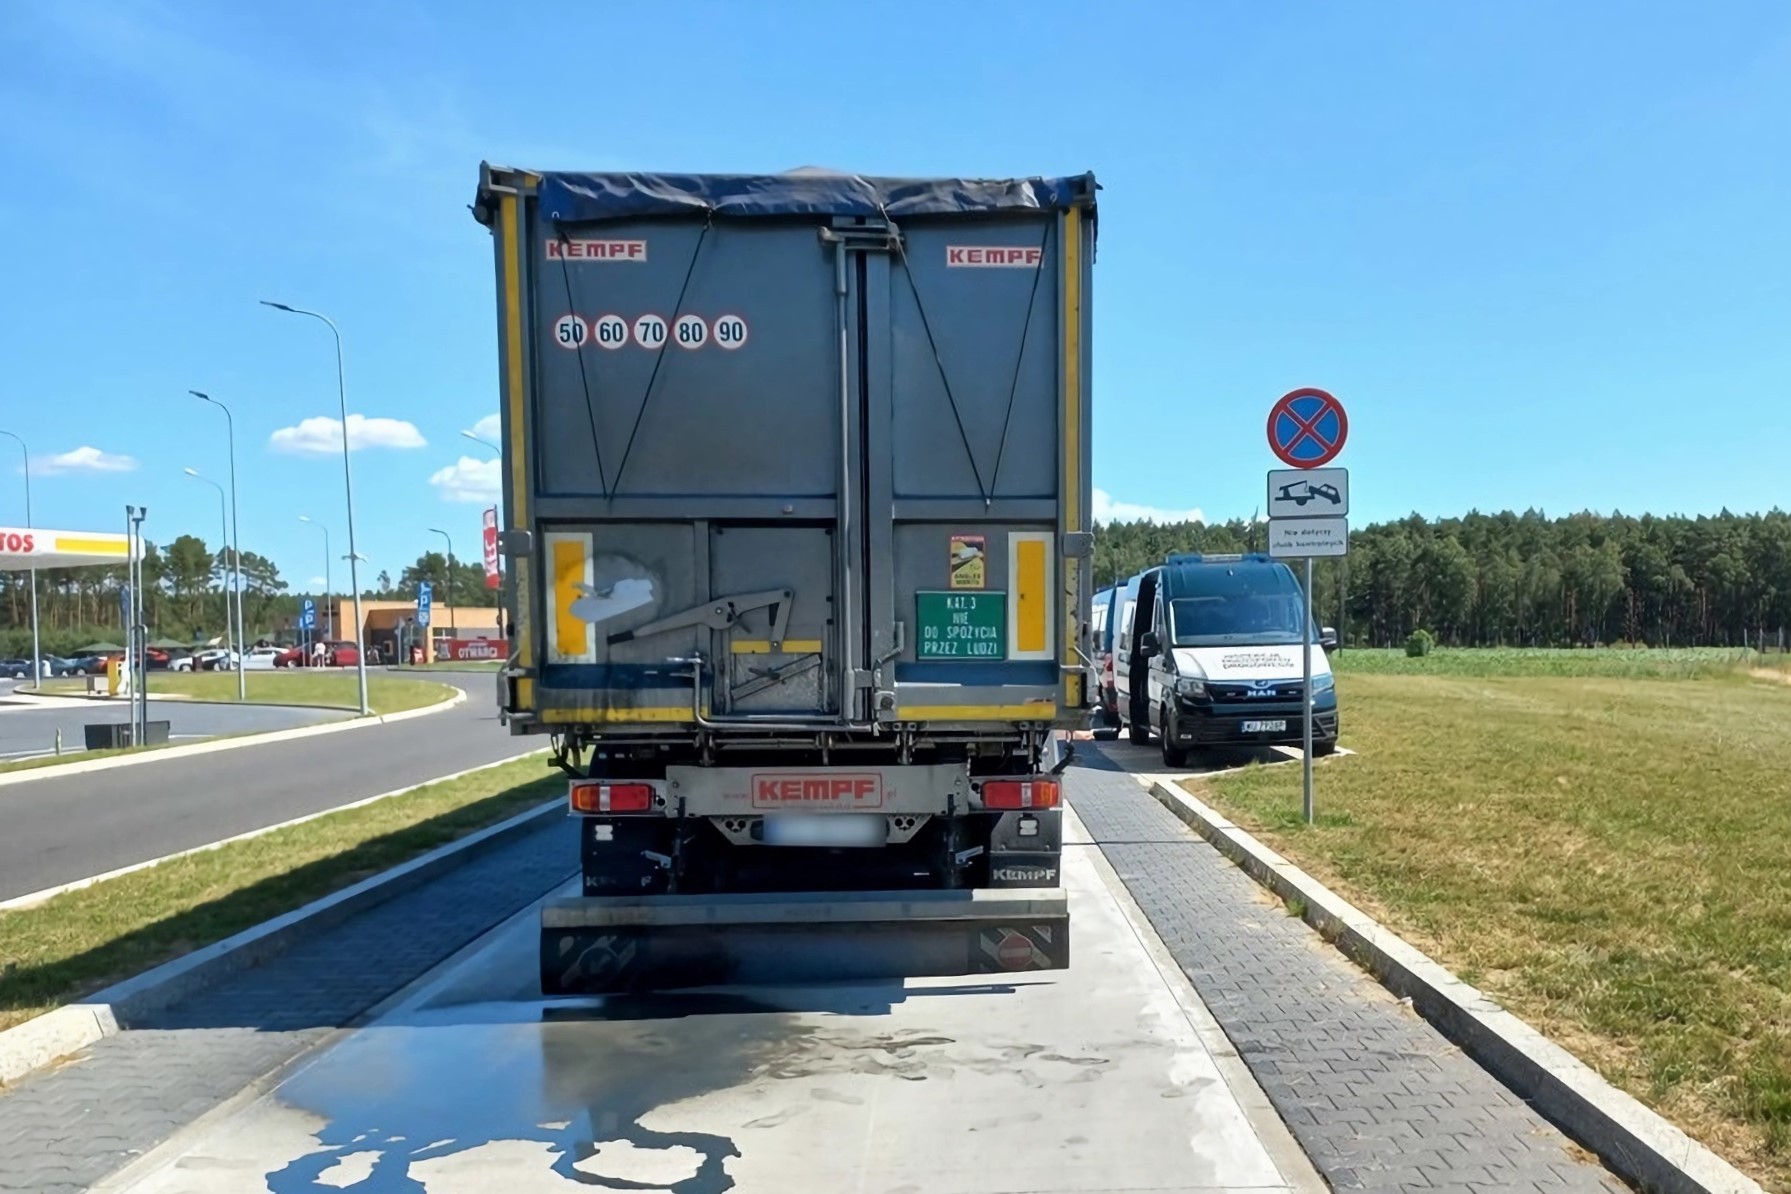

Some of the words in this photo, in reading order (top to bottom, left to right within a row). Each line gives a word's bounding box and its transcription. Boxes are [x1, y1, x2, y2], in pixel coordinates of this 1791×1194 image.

[549, 242, 643, 258] KEMPF
[949, 249, 1041, 264] KEMPF
[559, 323, 583, 343] 50
[599, 322, 624, 342] 60
[639, 322, 664, 342] 70
[679, 322, 702, 342] 80
[719, 321, 743, 341] 90
[970, 596, 976, 610] 3
[953, 612, 968, 625] NIE
[924, 626, 939, 639] DO
[924, 641, 957, 654] PRZEZ
[967, 642, 997, 655] LUDZI
[759, 780, 875, 801] KEMPF
[993, 869, 1057, 880] KEMPF
